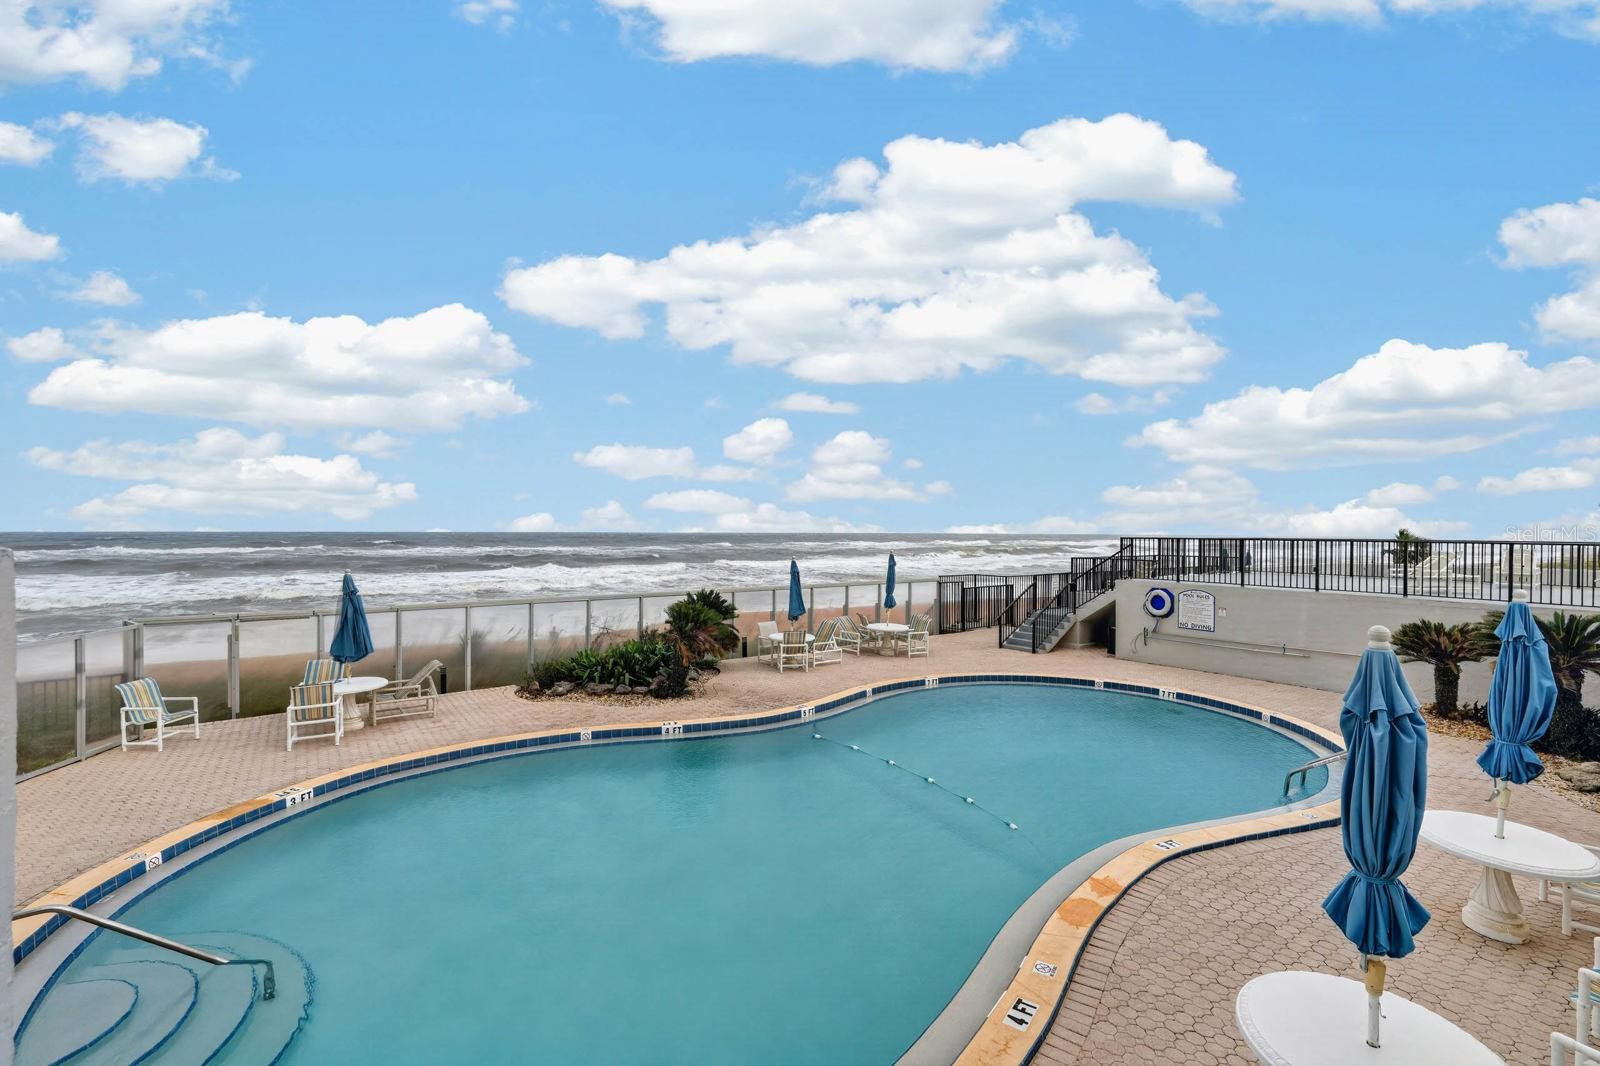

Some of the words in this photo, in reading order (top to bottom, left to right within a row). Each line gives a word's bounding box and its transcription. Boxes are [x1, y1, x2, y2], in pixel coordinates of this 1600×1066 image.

[1191, 622, 1212, 630] DIVING
[1168, 691, 1176, 699] FT
[290, 797, 296, 806] 3
[300, 791, 312, 802] FT
[1164, 839, 1181, 847] FT
[1012, 998, 1037, 1017] FT
[1007, 1014, 1029, 1025] 4
